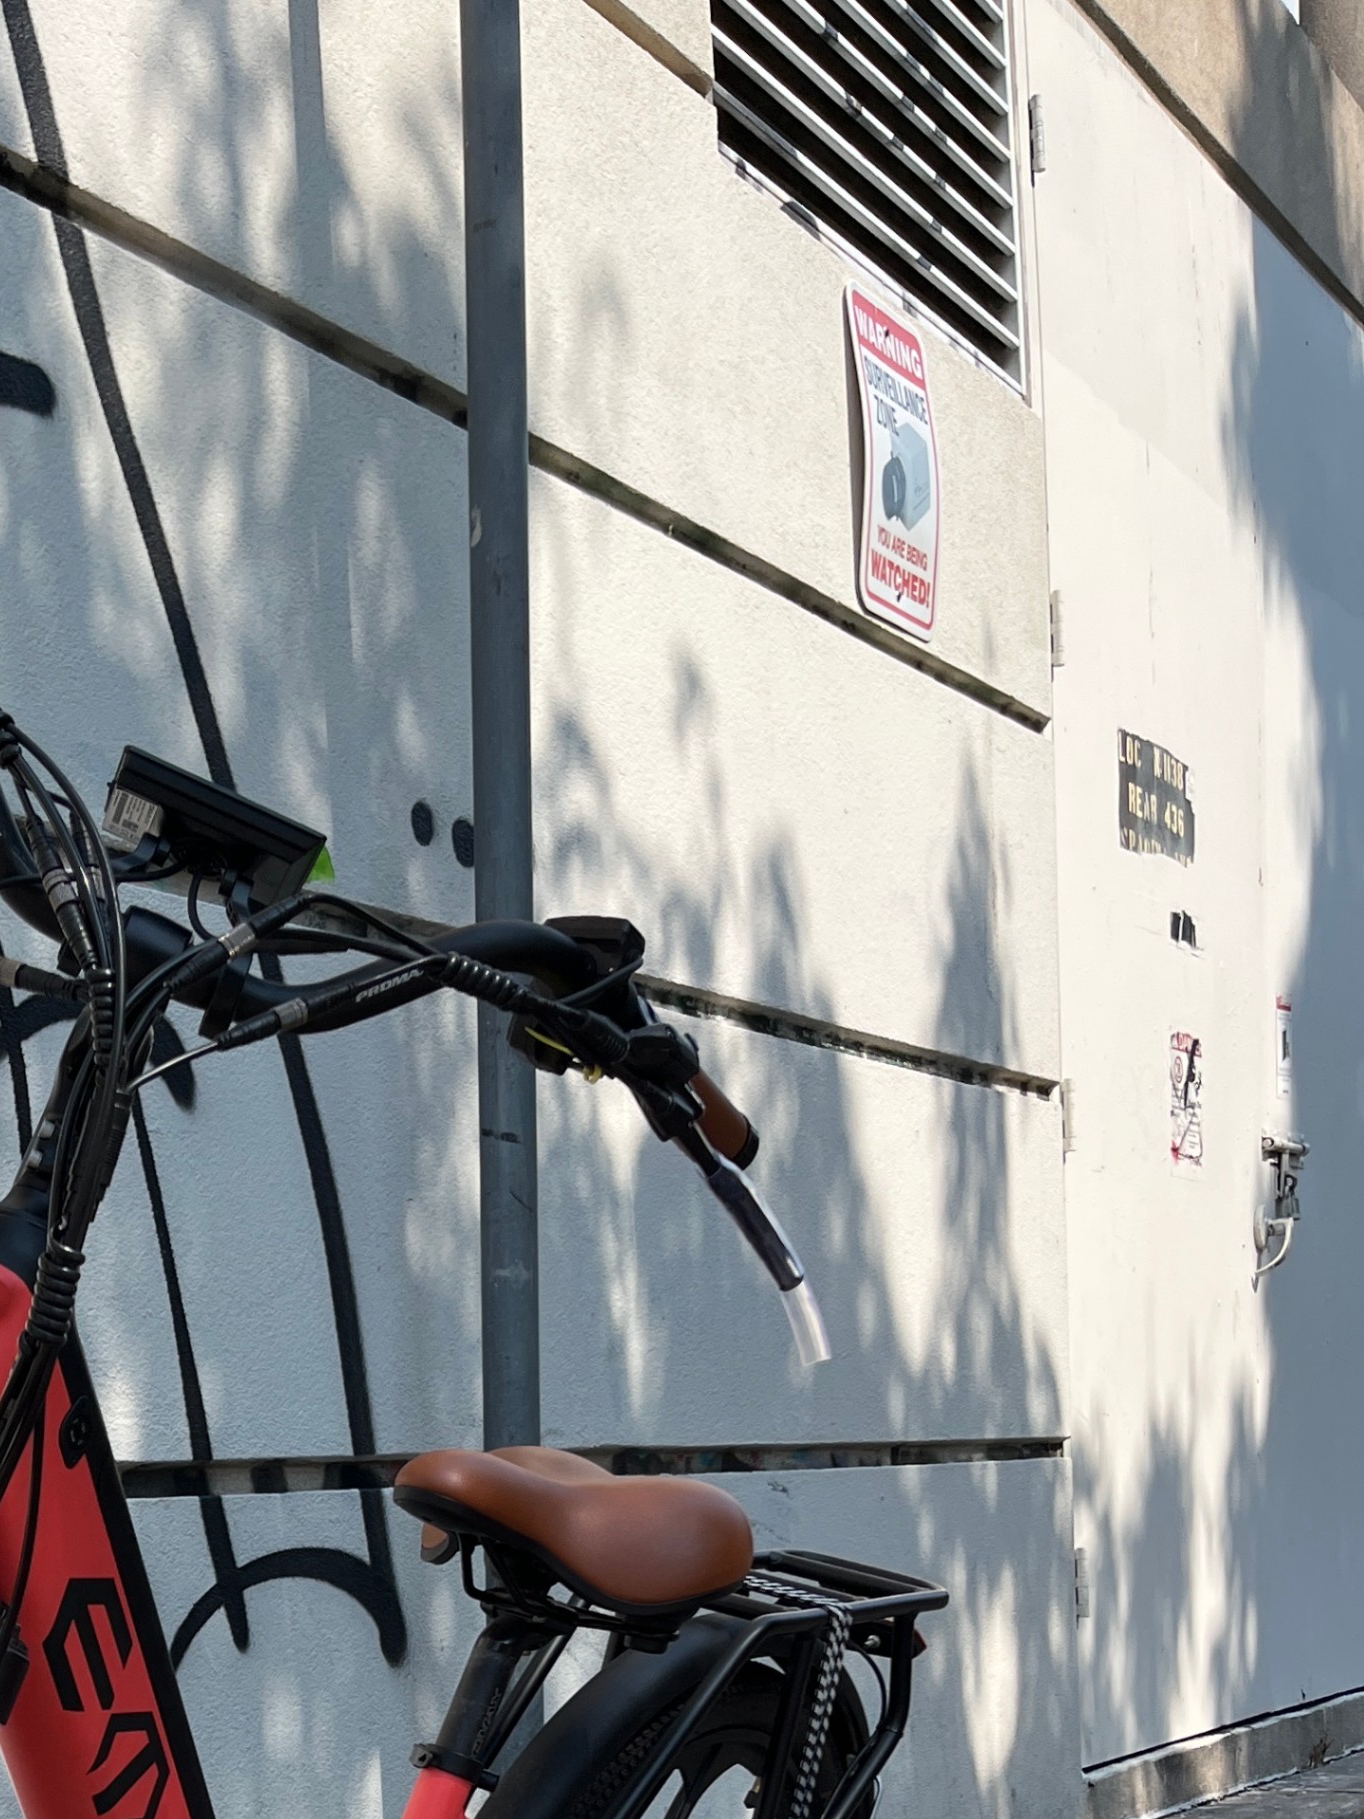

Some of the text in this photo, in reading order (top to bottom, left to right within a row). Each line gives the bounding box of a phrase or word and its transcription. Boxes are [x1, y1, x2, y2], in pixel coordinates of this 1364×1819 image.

[854, 305, 924, 380] WARNING
[864, 355, 928, 425] SURVEILLANCE
[874, 394, 899, 436] ZONE
[878, 524, 928, 571] YOU ARE BEING
[871, 548, 930, 608] WATCHED!
[1118, 731, 1141, 768] LOC
[1128, 782, 1184, 838] REAR 436
